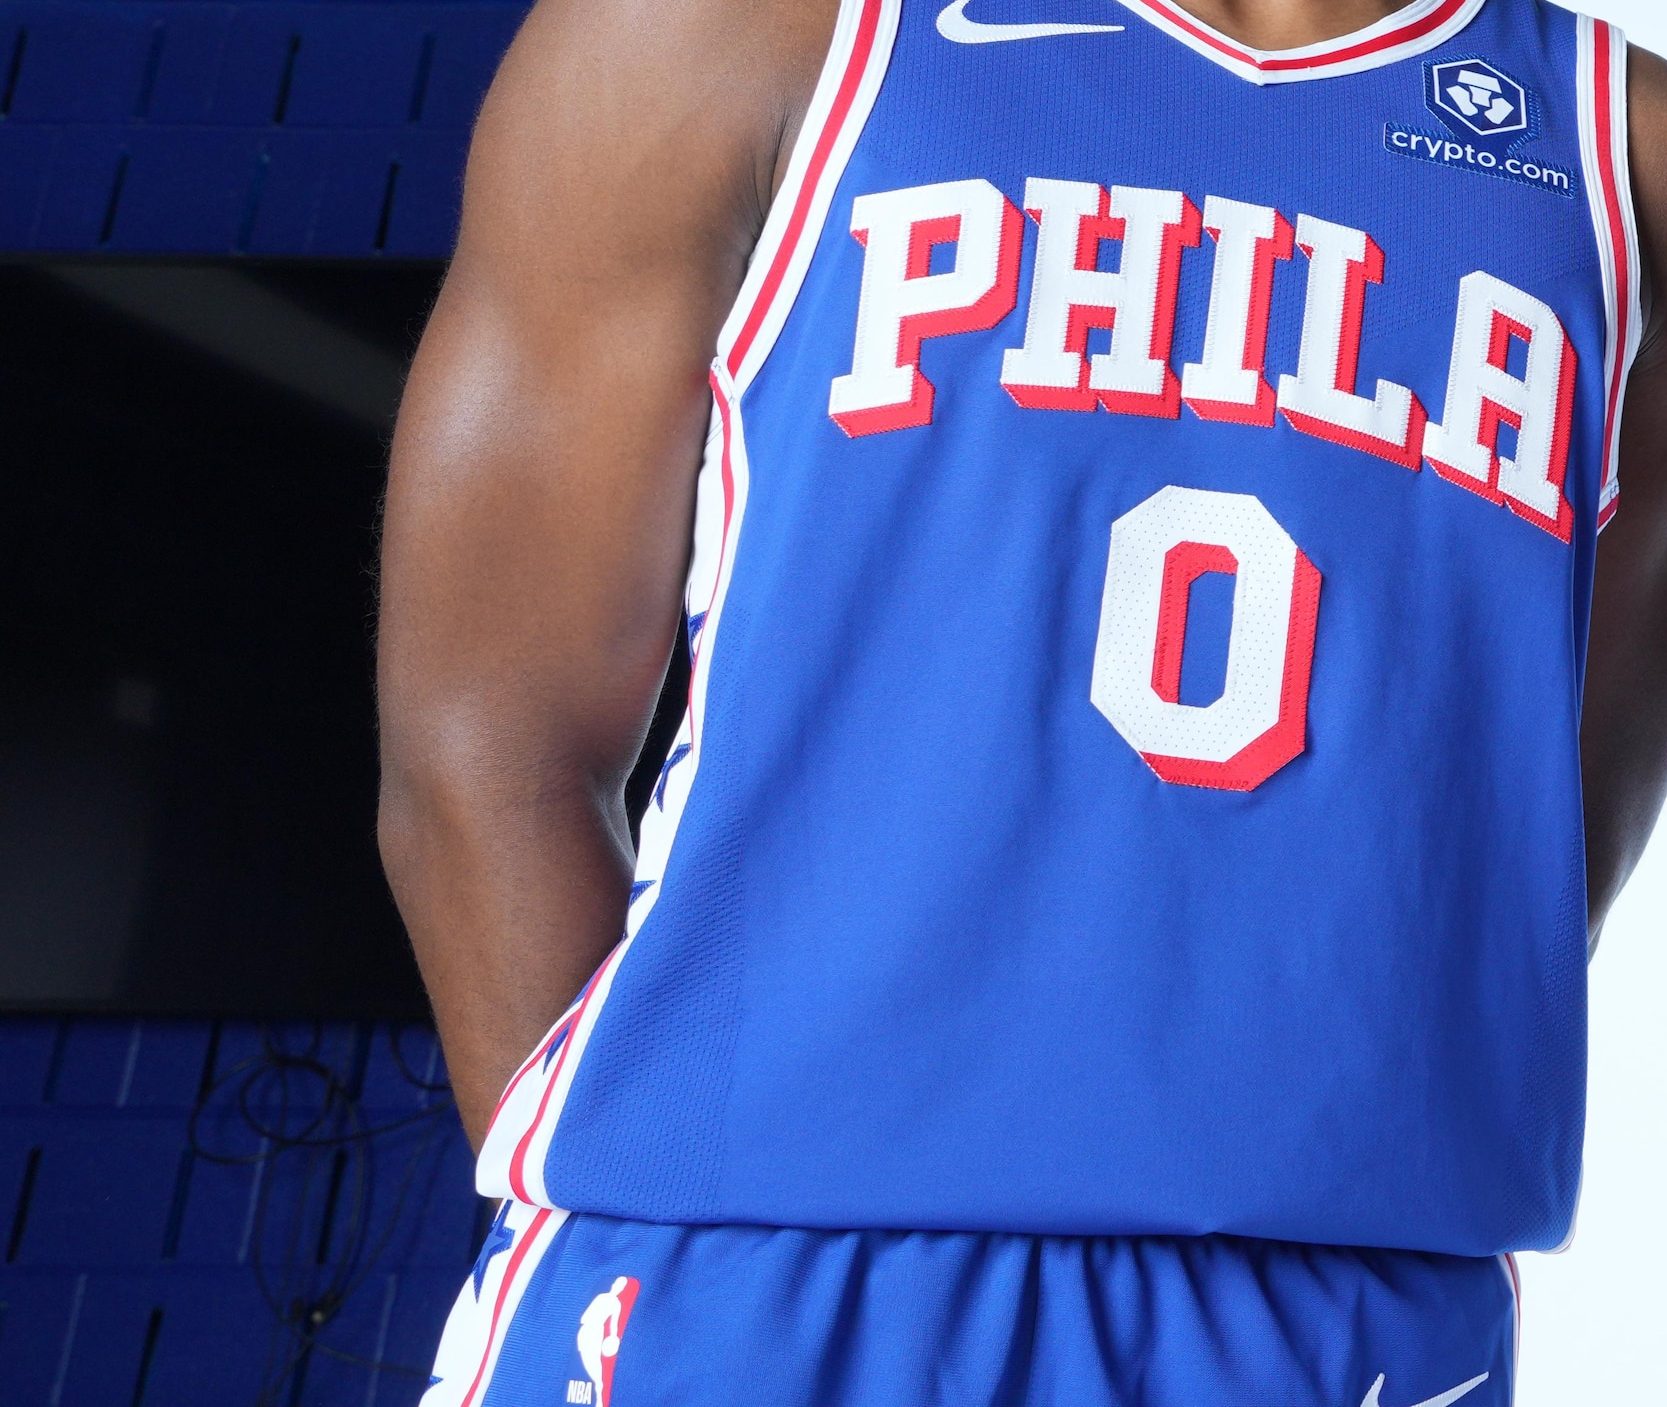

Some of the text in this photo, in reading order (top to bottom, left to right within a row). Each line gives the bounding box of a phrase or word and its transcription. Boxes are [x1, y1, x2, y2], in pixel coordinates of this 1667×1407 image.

[1391, 131, 1569, 190] crypto.com
[828, 176, 1576, 545] PHILA
[1090, 484, 1322, 792] 0
[566, 1379, 593, 1405] NBA
